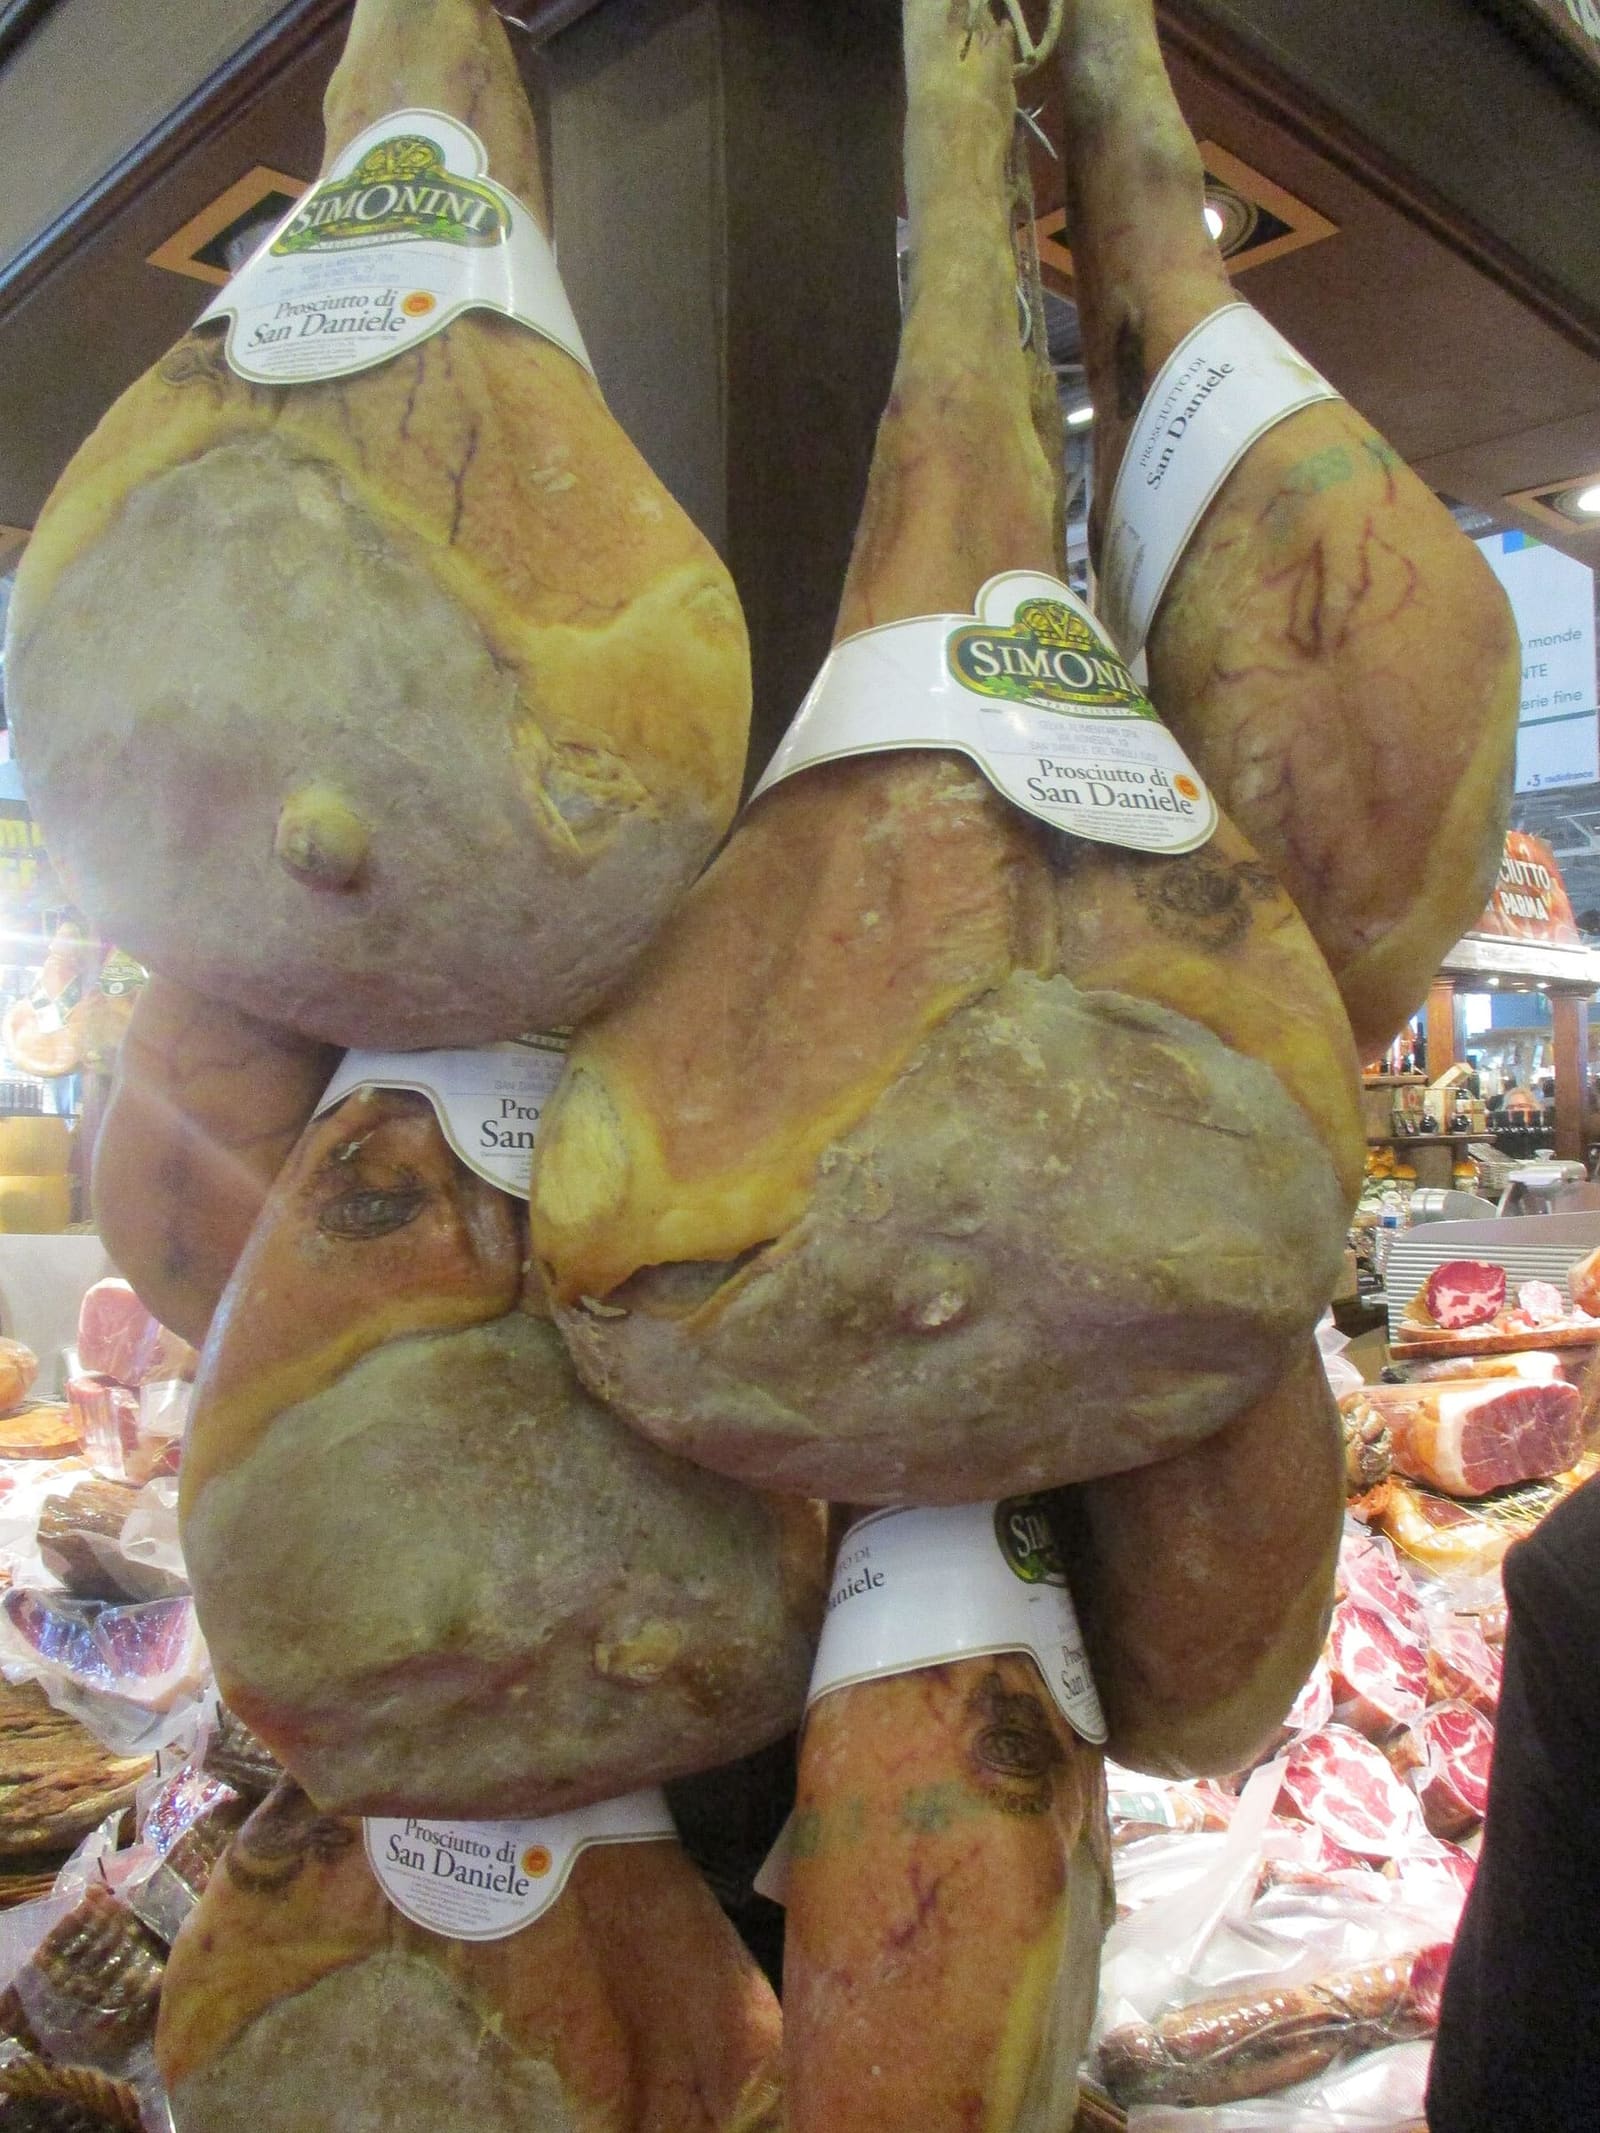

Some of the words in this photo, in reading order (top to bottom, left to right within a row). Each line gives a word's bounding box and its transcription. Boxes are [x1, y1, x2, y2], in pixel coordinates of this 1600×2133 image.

[290, 184, 493, 236] SIMONINI
[274, 296, 369, 320] Prosciutto
[374, 289, 398, 307] di
[248, 322, 291, 348] San
[299, 307, 407, 338] Daniele
[1146, 447, 1174, 491] San
[1167, 363, 1234, 440] Daniele
[1528, 628, 1582, 648] monde
[1554, 690, 1583, 704] fine
[1039, 759, 1145, 785] Prosciutto
[1150, 766, 1170, 788] di
[1027, 777, 1082, 805] San
[1088, 781, 1195, 815] Daniele
[1500, 891, 1549, 921] PARMA
[480, 1120, 535, 1149] San
[404, 1818, 491, 1859] Prosciutto
[496, 1841, 517, 1864] di
[385, 1833, 425, 1871] San
[432, 1848, 530, 1897] Daniele
